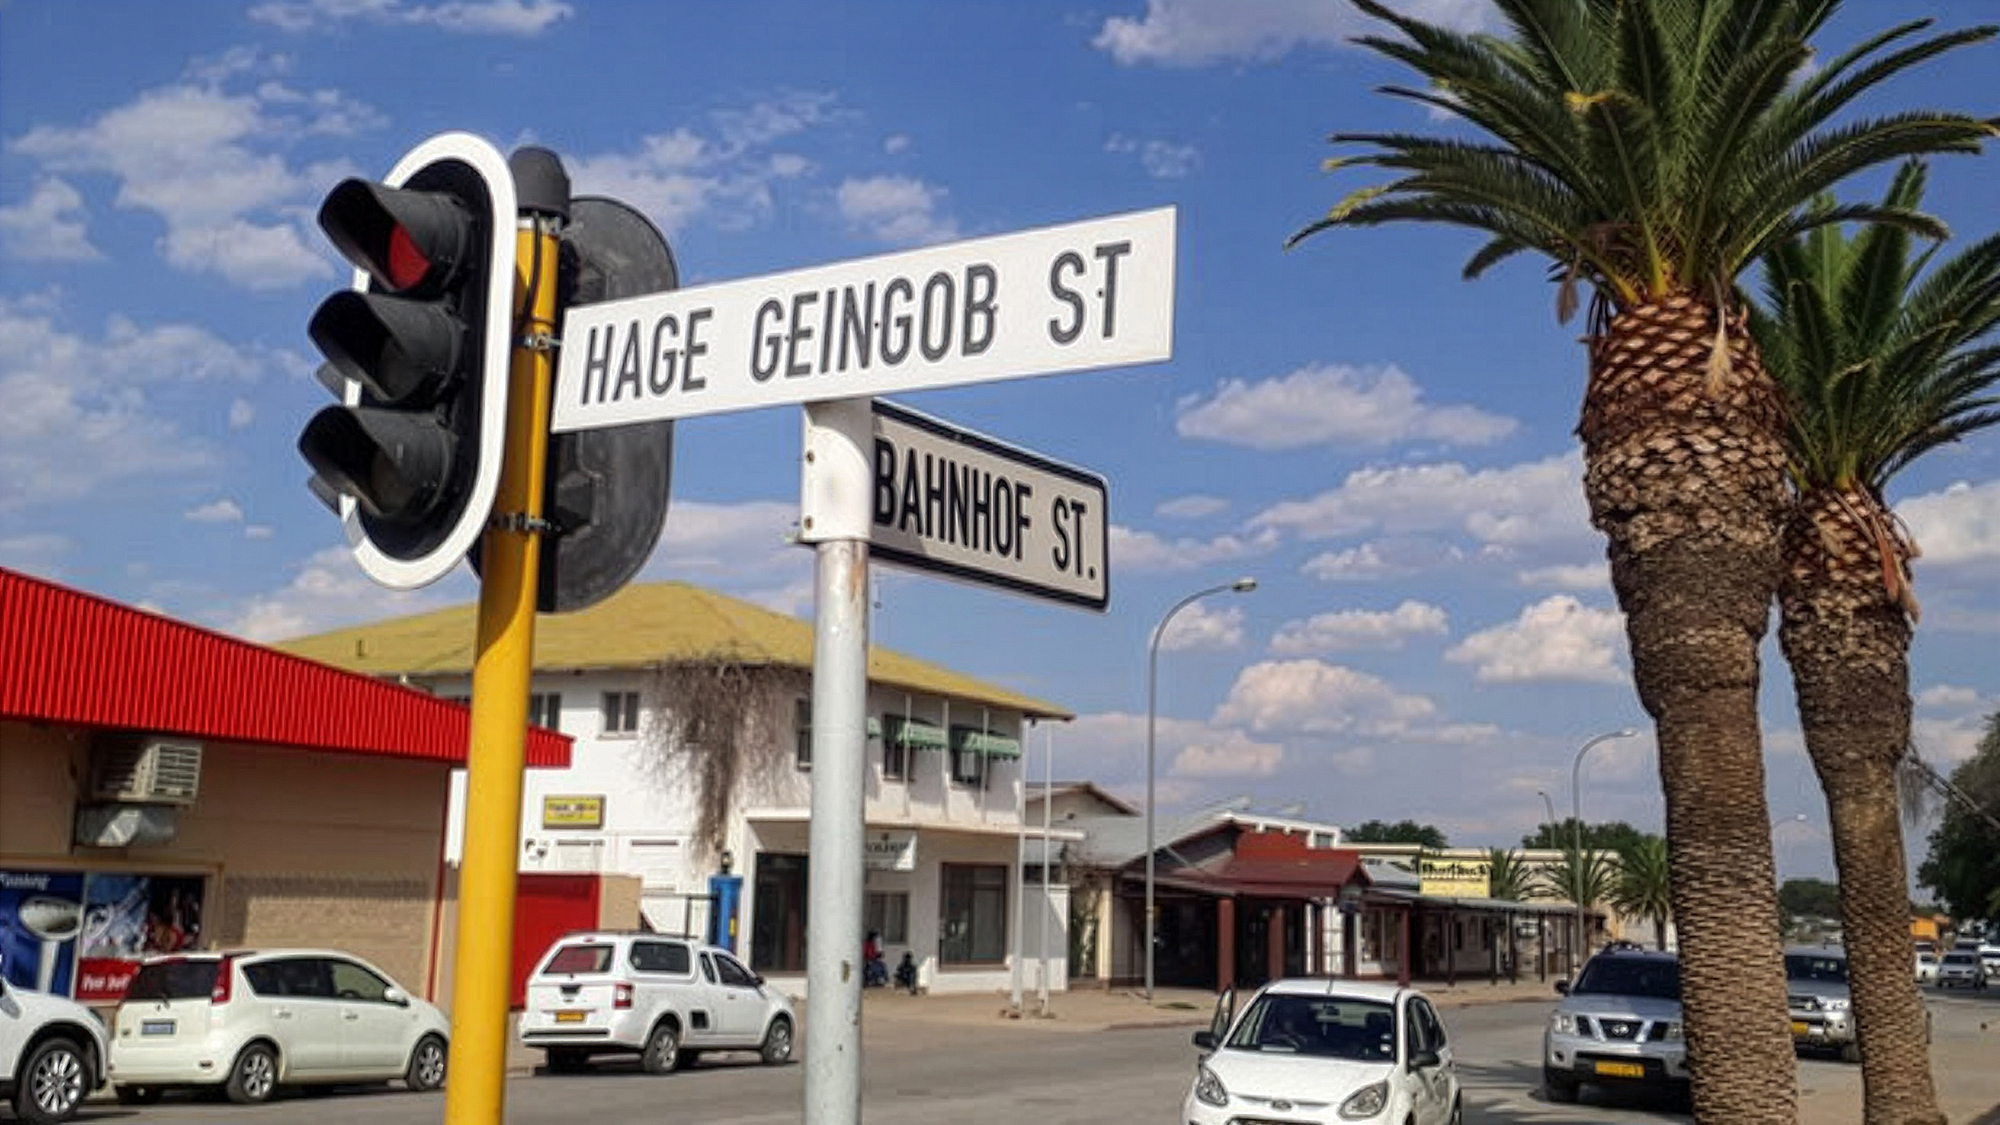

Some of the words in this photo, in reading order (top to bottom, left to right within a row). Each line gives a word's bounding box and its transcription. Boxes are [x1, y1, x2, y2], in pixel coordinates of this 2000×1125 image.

[582, 307, 713, 405] HAGE
[750, 263, 998, 383] GEINGOB
[1050, 241, 1131, 345] ST
[875, 438, 1032, 561] BAHNHOF
[1053, 497, 1096, 579] ST.
